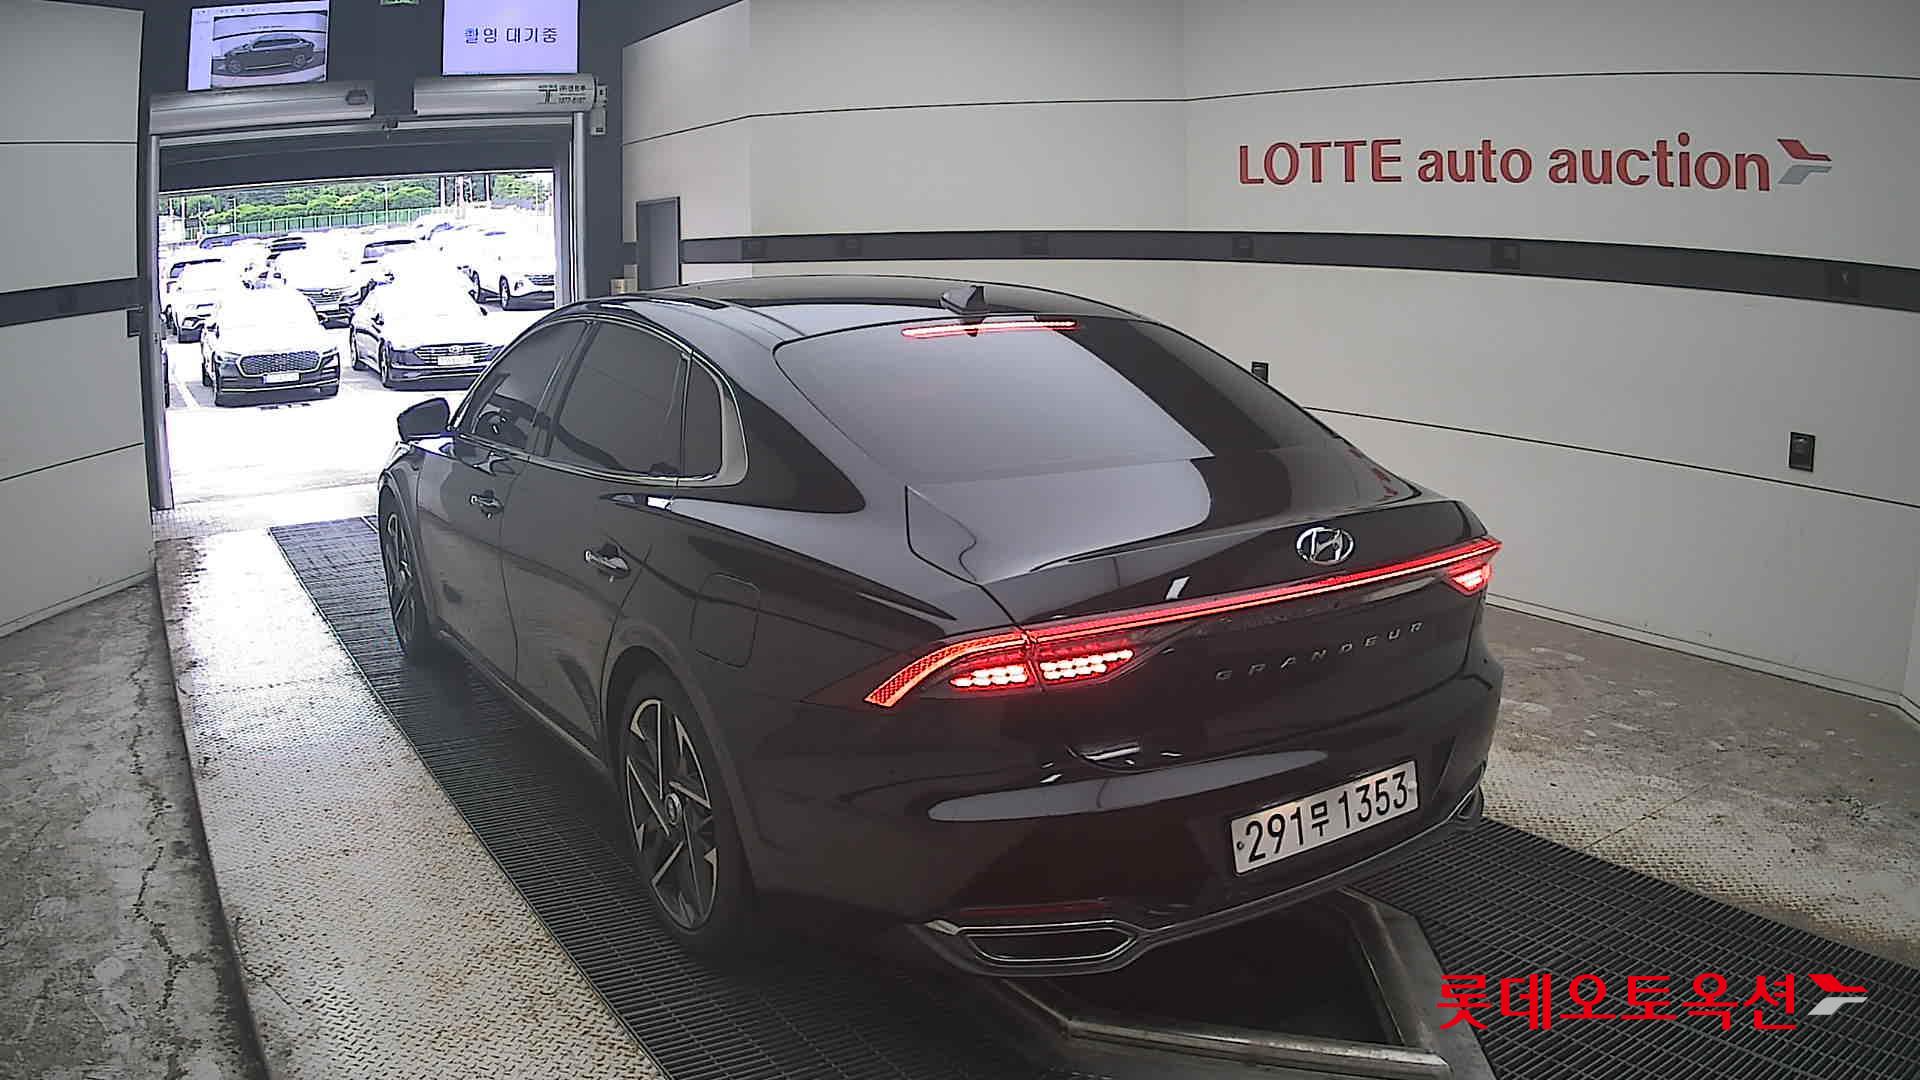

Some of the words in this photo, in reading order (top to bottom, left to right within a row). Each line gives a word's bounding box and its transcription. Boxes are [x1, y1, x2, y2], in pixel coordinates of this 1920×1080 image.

[505, 27, 558, 43] 대기중
[1239, 139, 1402, 185] LOTTE
[1417, 139, 1532, 183] auto
[1549, 132, 1770, 191] auction
[1215, 621, 1423, 681] GRANDEUR
